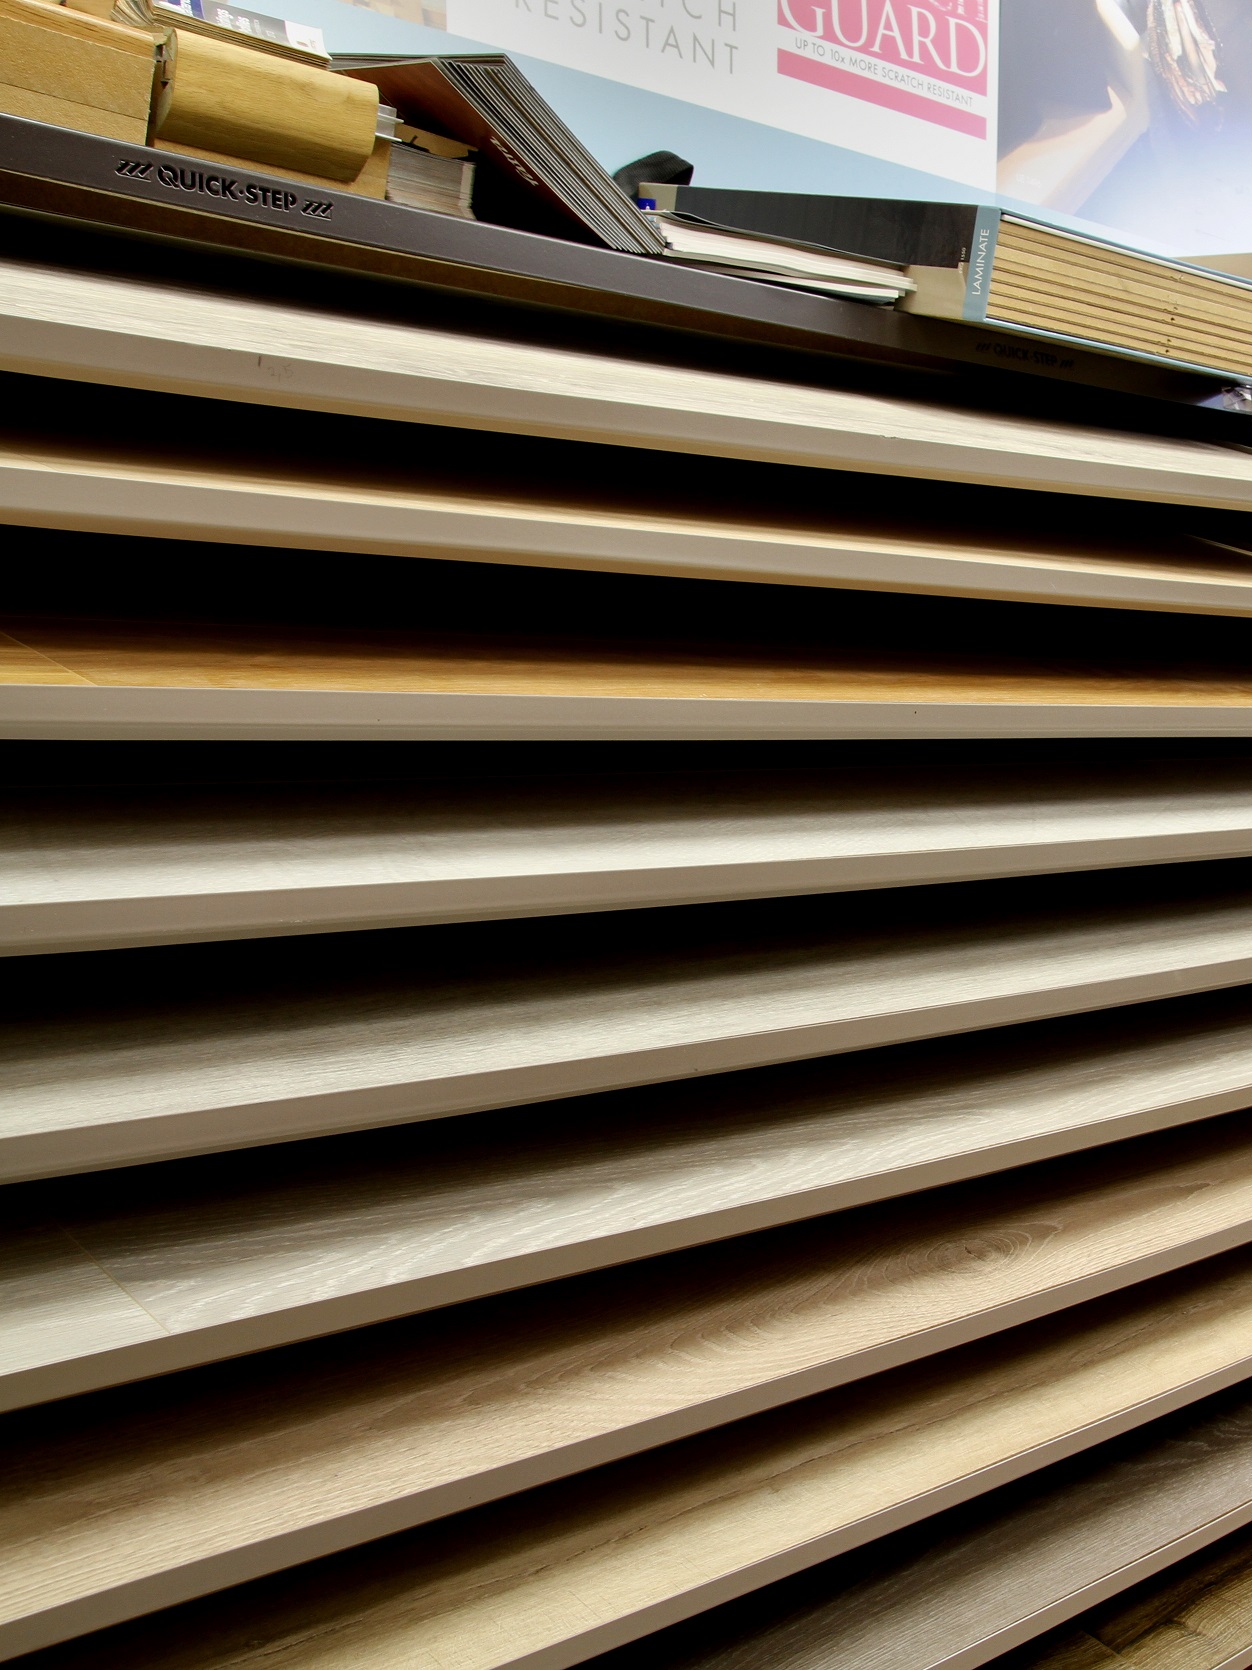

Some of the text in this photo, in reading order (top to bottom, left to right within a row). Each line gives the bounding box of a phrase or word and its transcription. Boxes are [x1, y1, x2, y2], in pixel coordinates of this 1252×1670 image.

[514, 0, 739, 75] ESISTANT
[780, 0, 987, 77] GUARD
[794, 36, 974, 108] UP TO 10x MORE SCRATCH RESISTANT
[971, 228, 990, 295] LAMINATE
